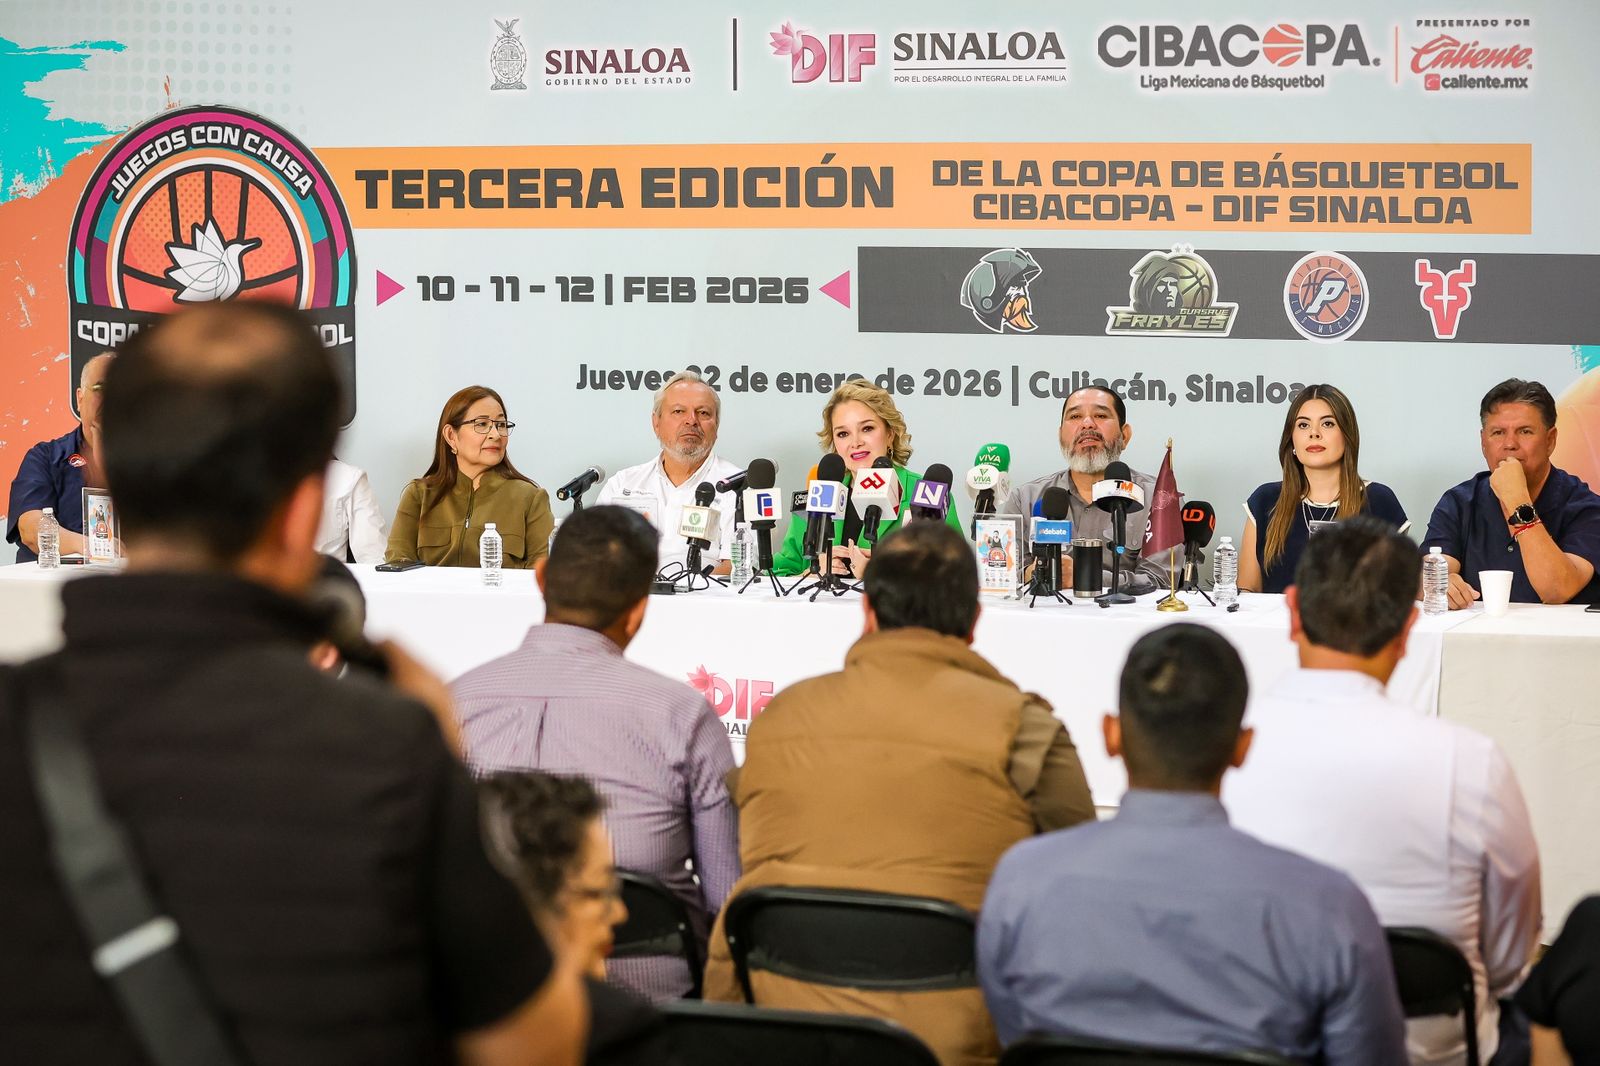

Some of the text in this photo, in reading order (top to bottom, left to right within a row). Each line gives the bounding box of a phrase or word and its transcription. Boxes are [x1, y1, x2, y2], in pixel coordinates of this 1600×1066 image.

[1416, 19, 1530, 27] PRESENTADO POR
[792, 33, 877, 83] DIF
[893, 31, 1066, 62] SINALOA
[545, 48, 691, 75] SINALOA
[545, 78, 608, 86] GOBIERNO
[644, 77, 691, 85] ESTADO
[894, 75, 910, 83] POR
[912, 75, 921, 83] EL
[923, 75, 972, 83] DESARROLLO
[1140, 75, 1325, 91] Liga Mexicana de Básquetbol
[1441, 74, 1528, 89] caliente.mx
[110, 126, 313, 200] JUEGOS CON CAUSA
[933, 153, 1518, 189] DE LA COPA DE BÁSQUETBOL
[355, 153, 894, 209] TERCERA EDICIÓN
[974, 194, 1175, 221] CIBACOPA
[1213, 196, 1278, 223] DIF
[1289, 196, 1472, 225] SINALOA
[417, 276, 454, 301] 10
[490, 276, 519, 302] 11
[555, 276, 594, 302] 12
[624, 277, 696, 303] FEB
[706, 277, 809, 303] 2026
[1306, 280, 1345, 313] P
[1115, 314, 1230, 329] FRAYLES
[1180, 308, 1229, 316] GUASAVE
[729, 366, 768, 392] de
[875, 367, 915, 395] de
[923, 369, 1001, 397] 2026
[979, 454, 1001, 463] VIVA
[1114, 480, 1134, 493] TM
[705, 675, 775, 720] DIF
